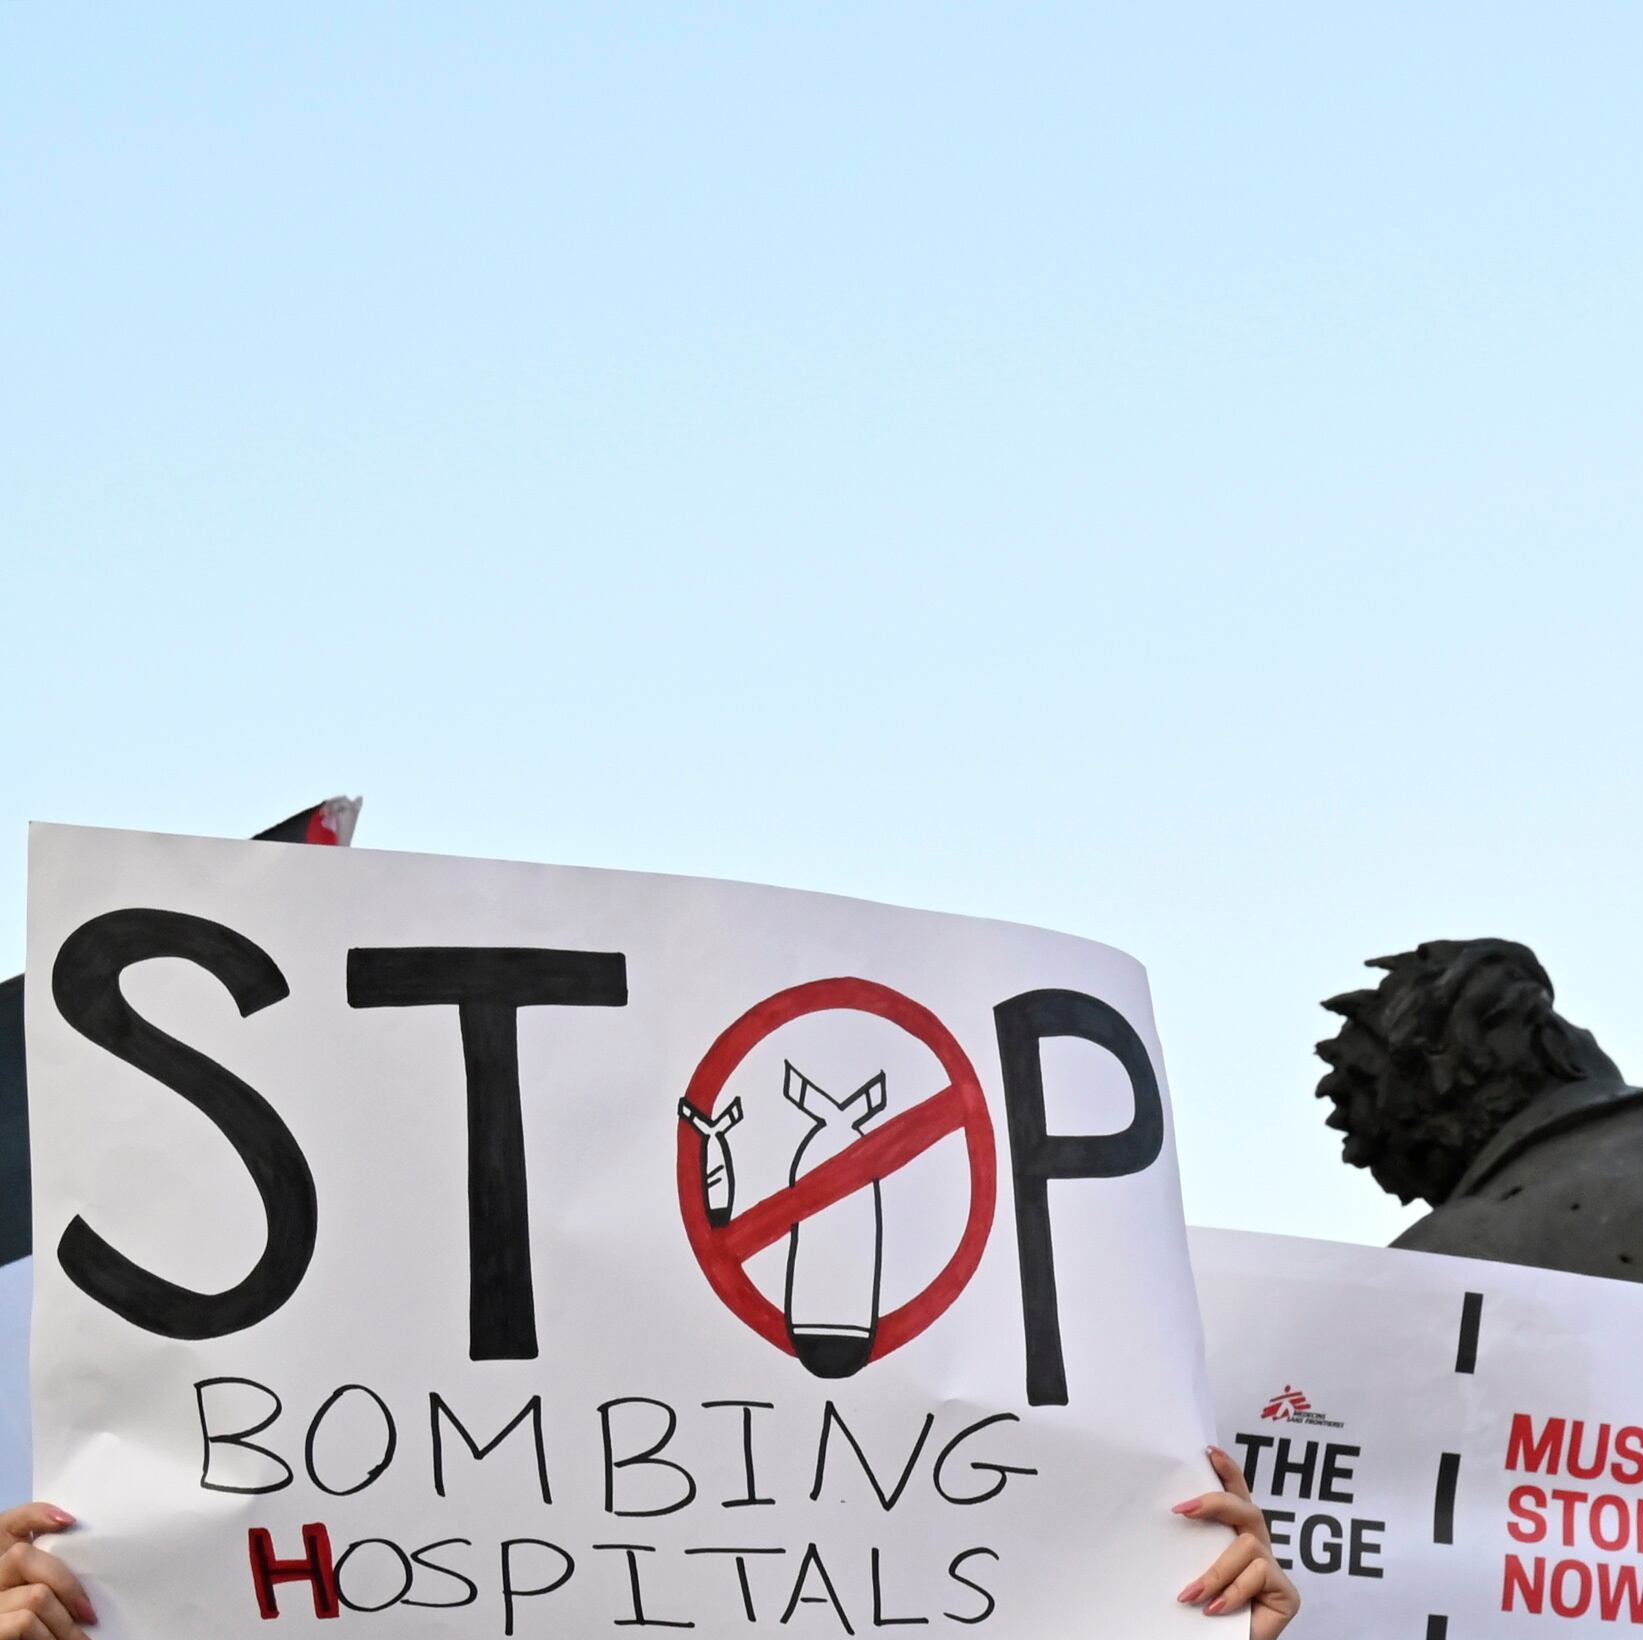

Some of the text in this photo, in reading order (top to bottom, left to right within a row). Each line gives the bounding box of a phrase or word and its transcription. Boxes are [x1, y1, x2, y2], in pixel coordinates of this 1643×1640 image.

[52, 908, 1164, 1407] STOP
[195, 1377, 1039, 1518] BOMBING
[1235, 1432, 1361, 1503] THE
[248, 1522, 1001, 1637] HOSPITALS
[1262, 1508, 1386, 1579] EGE
